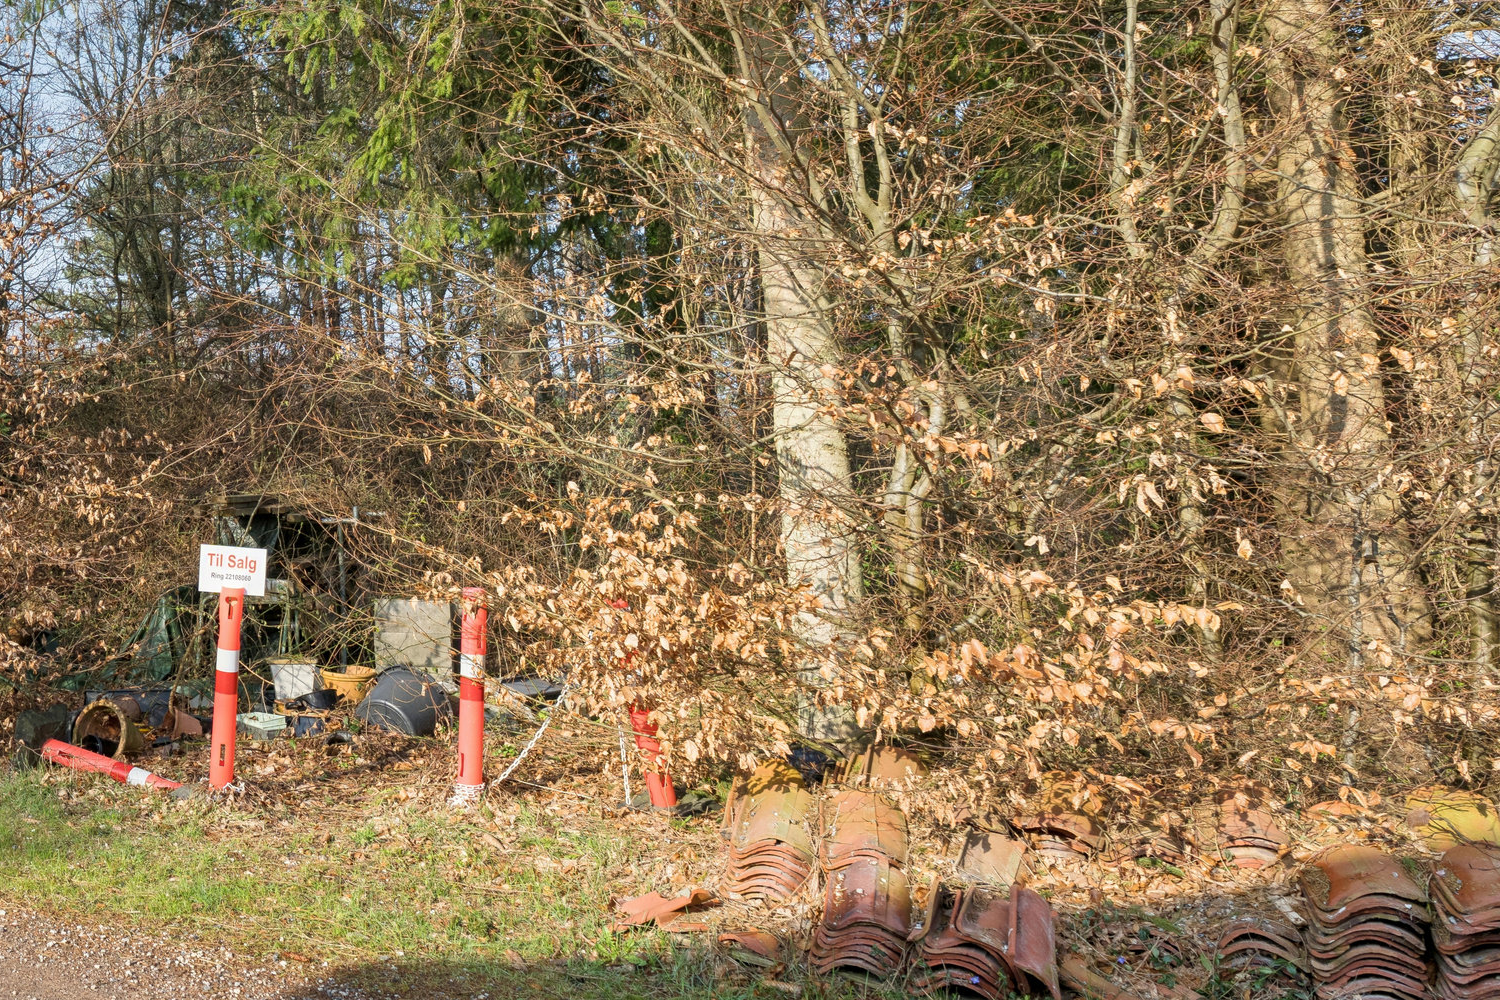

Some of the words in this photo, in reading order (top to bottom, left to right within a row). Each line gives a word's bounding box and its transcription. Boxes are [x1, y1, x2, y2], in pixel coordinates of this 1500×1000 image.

[207, 553, 223, 567] Til
[227, 554, 257, 573] Salg
[211, 572, 224, 580] Ring
